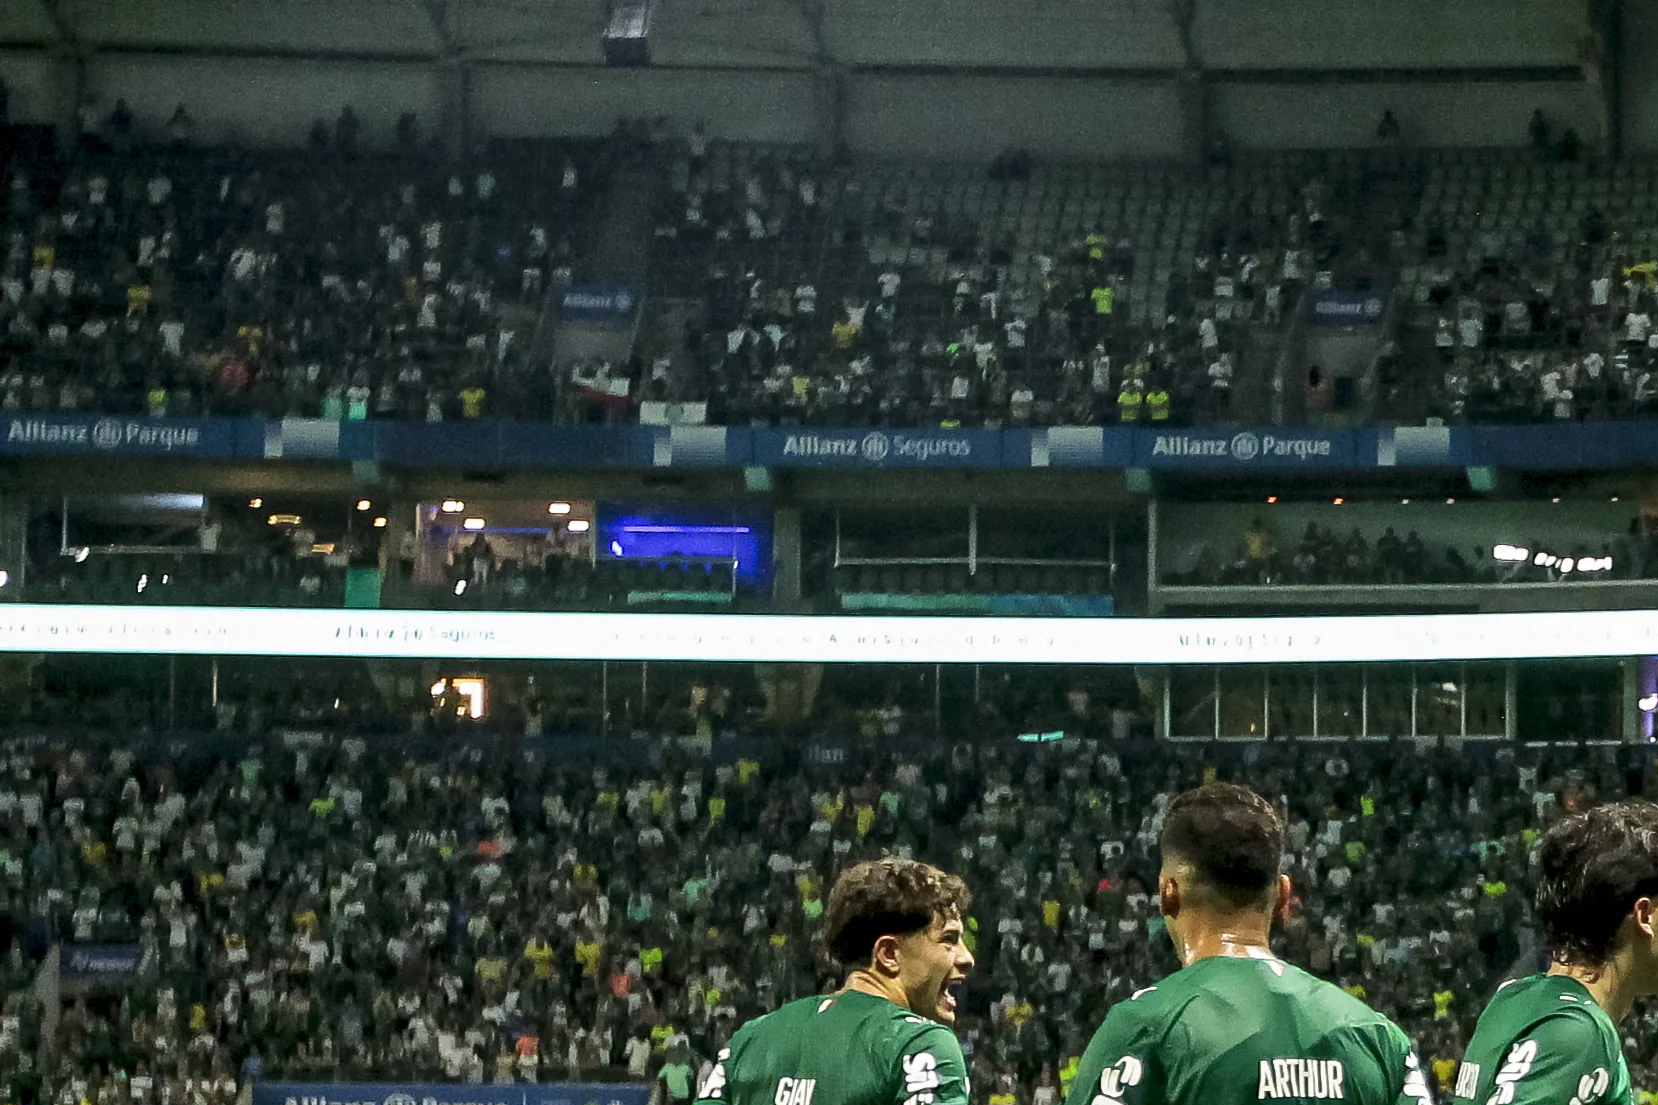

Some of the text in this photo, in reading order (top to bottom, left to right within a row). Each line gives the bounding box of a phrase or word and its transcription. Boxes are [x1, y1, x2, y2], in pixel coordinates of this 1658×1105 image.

[7, 419, 199, 451] Allianz Parque
[783, 434, 972, 461] Allianz Seguros
[1152, 434, 1331, 460] Allianz Parque
[1258, 1058, 1344, 1100] ARTHUR
